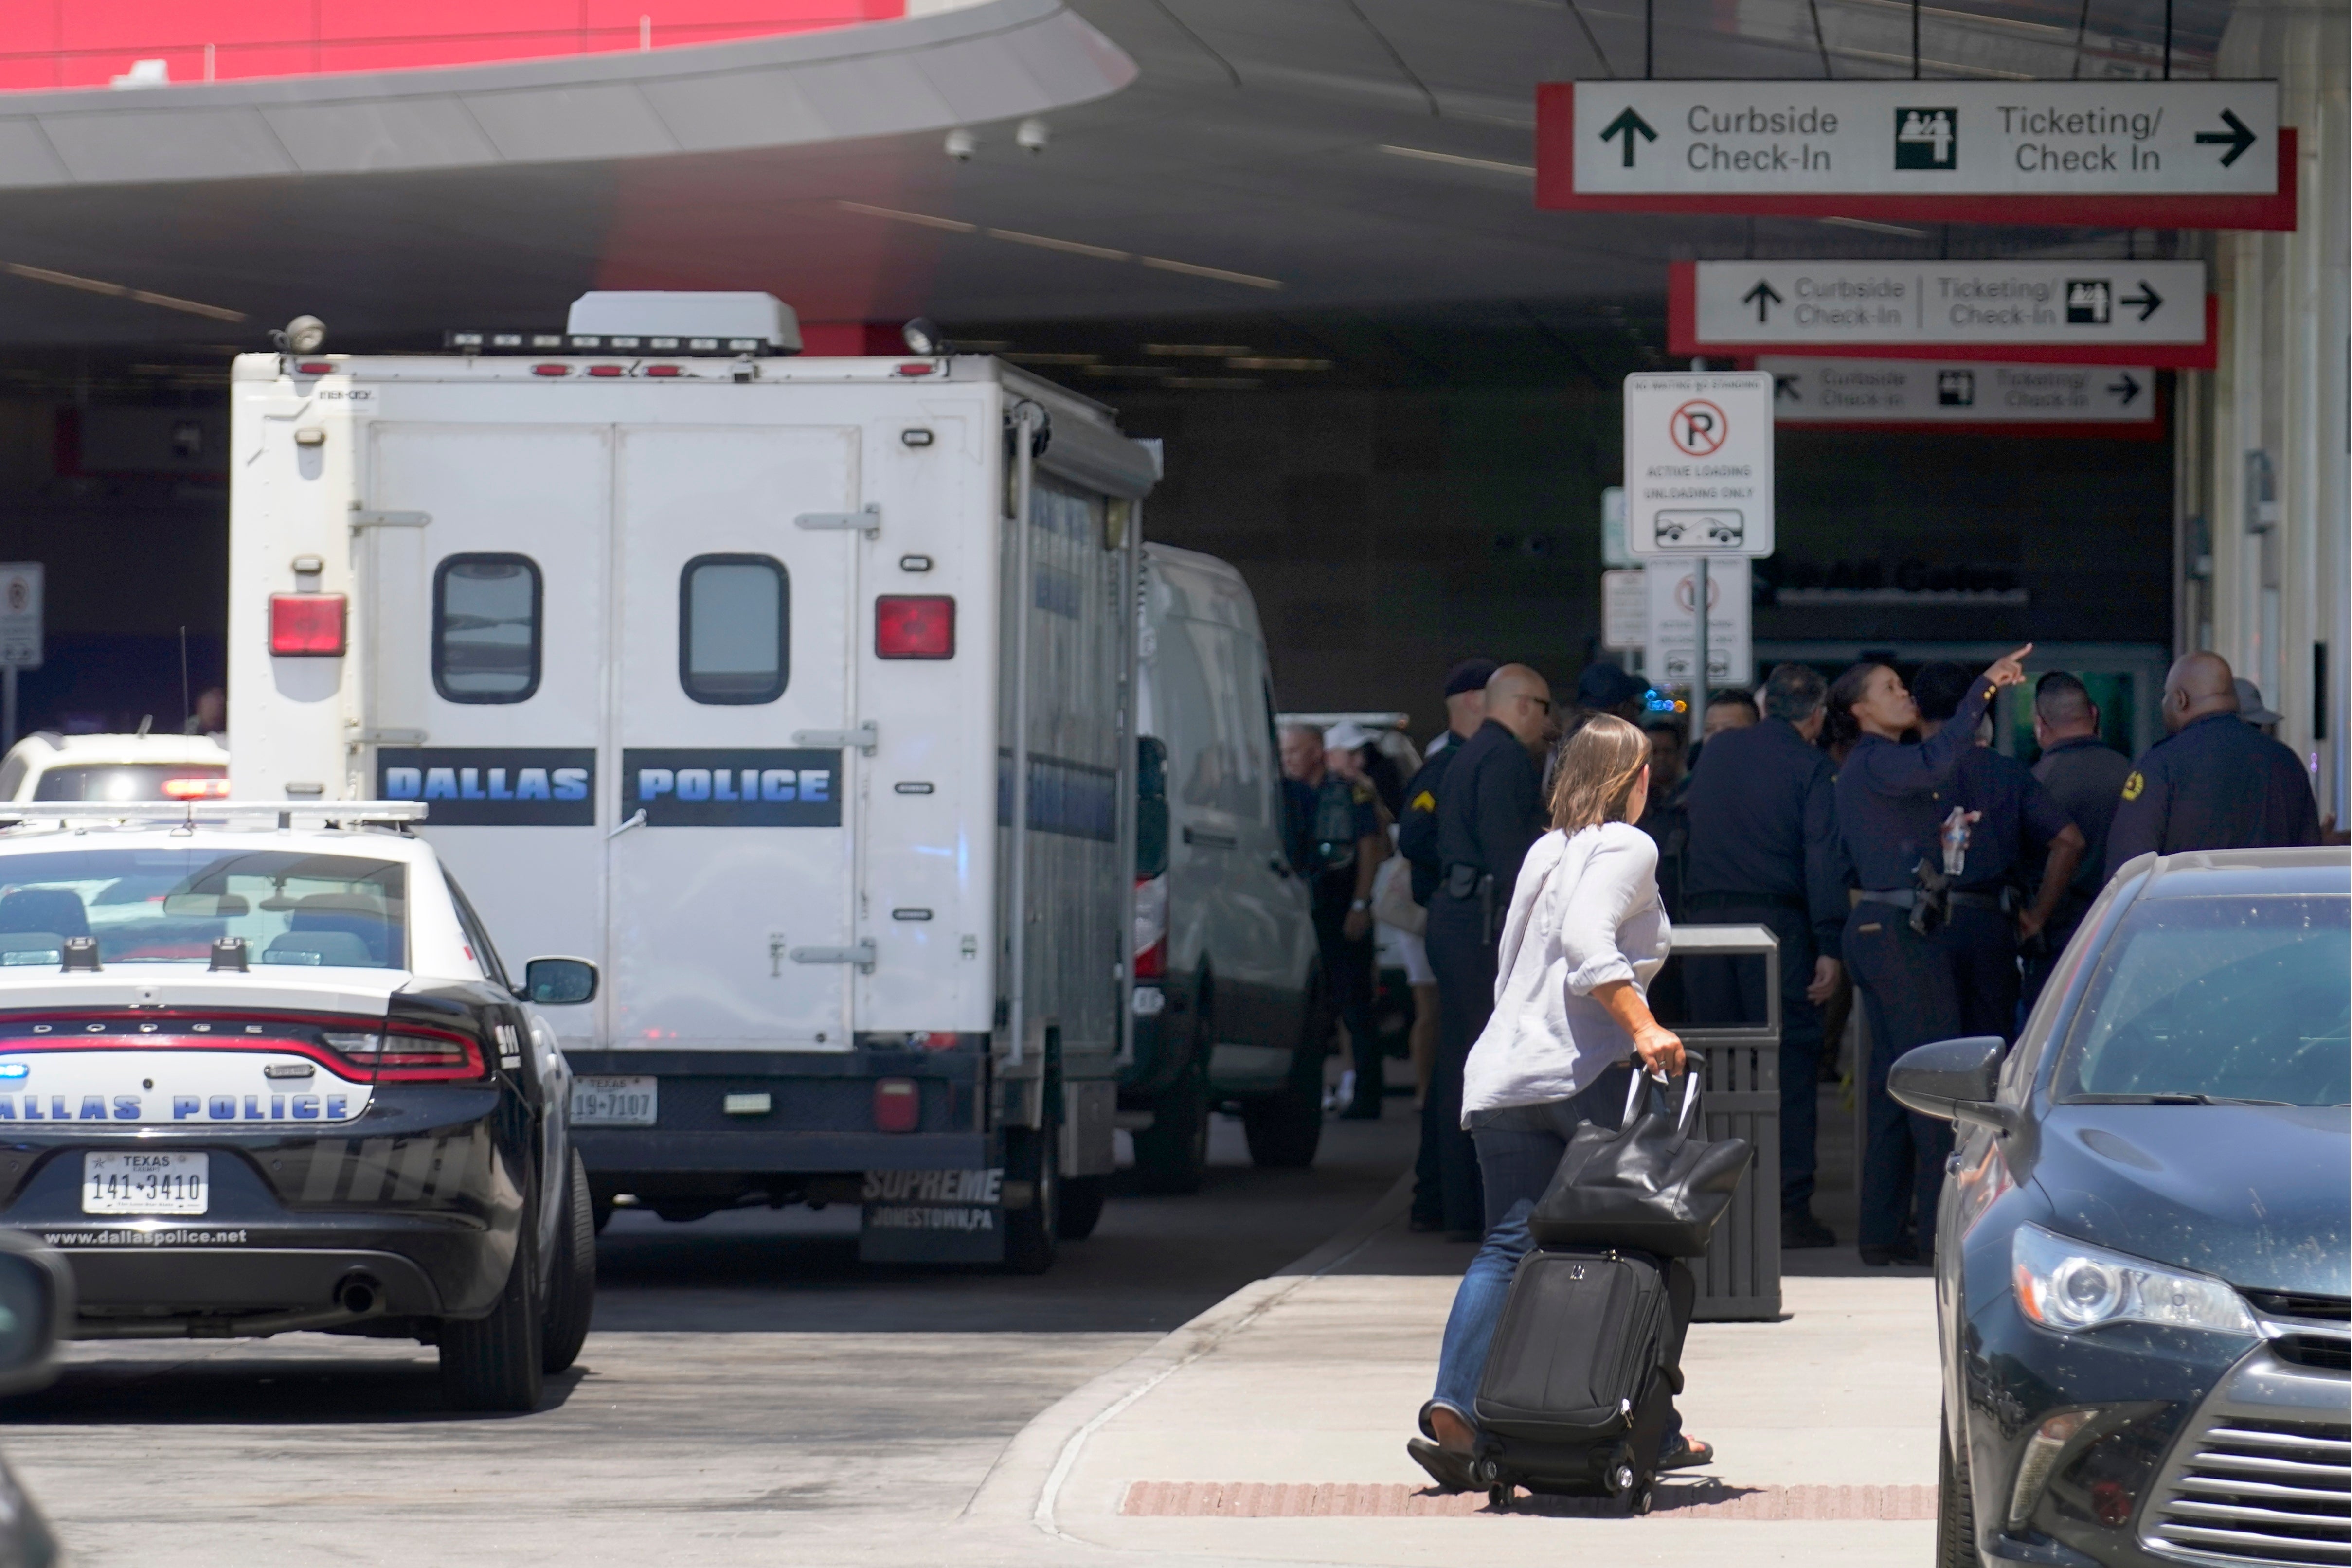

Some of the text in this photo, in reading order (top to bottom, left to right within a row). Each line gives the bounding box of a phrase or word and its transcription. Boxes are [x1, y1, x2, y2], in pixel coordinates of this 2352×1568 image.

[1688, 104, 1838, 134] Curbside
[1997, 106, 2163, 140] Ticketing/
[1688, 142, 1831, 171] Check-In
[2016, 143, 2160, 171] Check In
[1795, 276, 1905, 299] Curbside
[1938, 277, 2059, 302] Ticketing/
[1647, 465, 1752, 478] ACTIVE LOADING
[1644, 487, 1755, 500] UNLOADING ONLY
[386, 767, 830, 801] DALLAS POLICE
[33, 1023, 263, 1033] DODGE
[590, 1079, 626, 1087] TEXAS
[173, 1094, 348, 1119] POLICE
[571, 1094, 650, 1115] 19 7107
[124, 1156, 170, 1167] TEXAS
[93, 1174, 200, 1200] 141 3410
[862, 1168, 1005, 1203] SUPREME
[45, 1229, 247, 1247] www.dallaspolice.net
